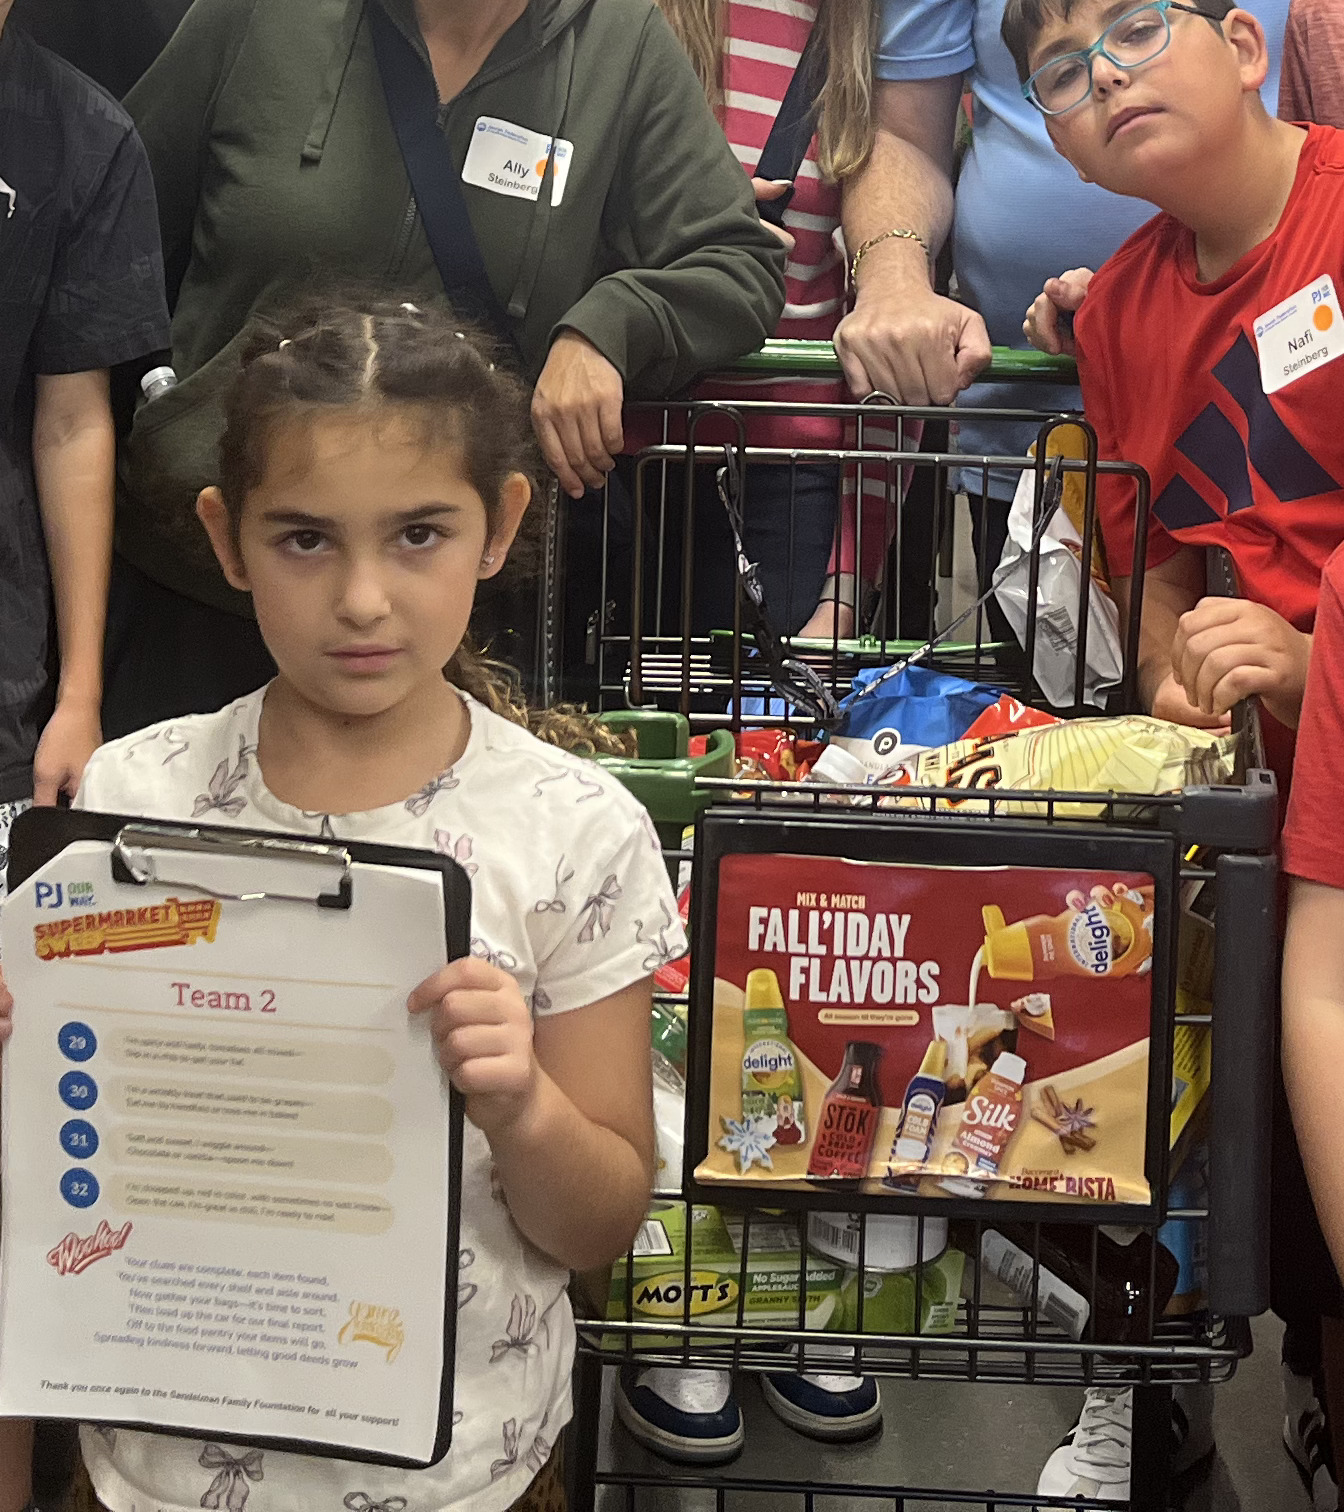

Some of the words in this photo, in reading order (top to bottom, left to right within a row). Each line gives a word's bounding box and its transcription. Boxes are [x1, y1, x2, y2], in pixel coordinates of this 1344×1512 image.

[503, 159, 530, 179] Ally
[488, 172, 538, 195] Steinberg
[1288, 329, 1314, 354] Nafi
[1284, 346, 1328, 376] Steinberg
[35, 882, 63, 909] PJ
[68, 882, 93, 893] OUR
[797, 892, 816, 906] MIX
[820, 894, 827, 907] &
[831, 894, 866, 909] MATCH
[34, 904, 170, 940] SUPERMARKET
[748, 906, 911, 957] FALL'IDAY
[1090, 907, 1110, 974] delight
[789, 956, 940, 1003] FLAVORS
[172, 983, 252, 1011] Team
[261, 990, 277, 1013] 2
[744, 1052, 792, 1071] delight
[963, 1096, 1016, 1134] Silk
[769, 1273, 798, 1285] Sugar
